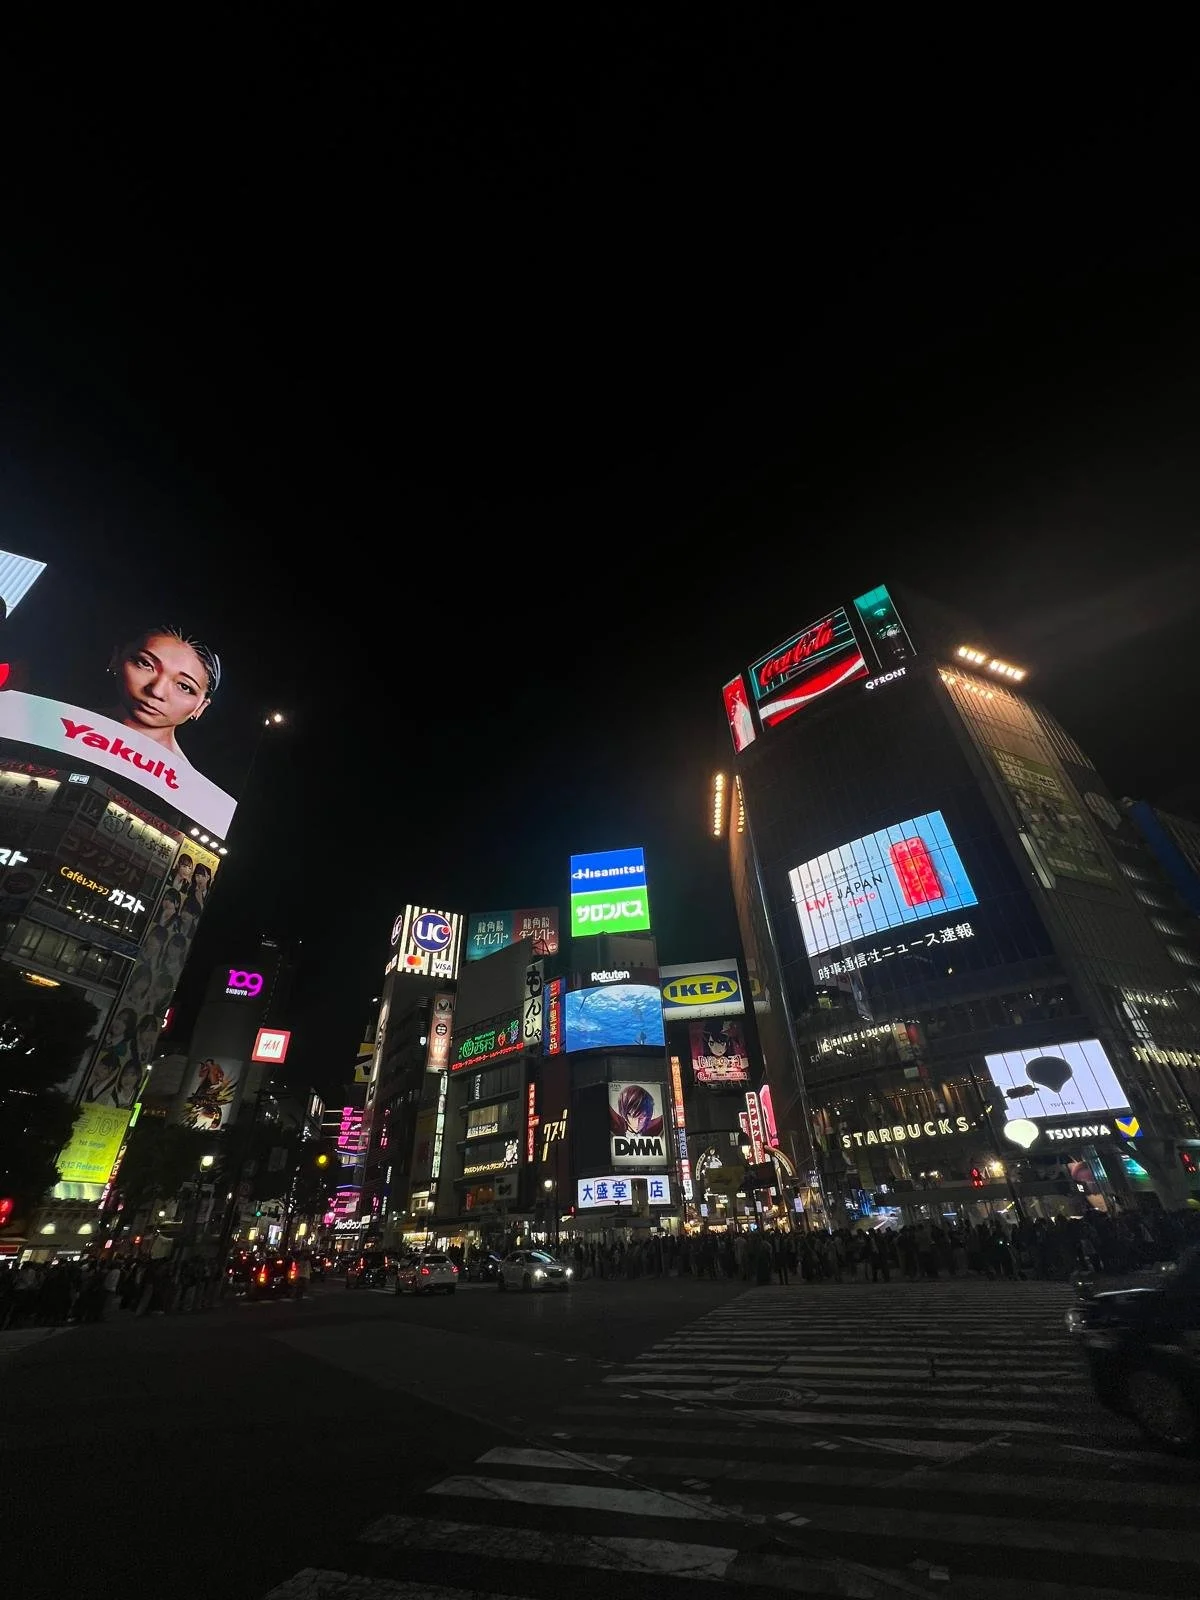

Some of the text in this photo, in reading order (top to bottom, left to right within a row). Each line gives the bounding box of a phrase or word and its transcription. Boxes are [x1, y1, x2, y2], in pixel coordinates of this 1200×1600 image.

[865, 667, 907, 690] QFRONT
[60, 717, 179, 790] Yakult
[572, 865, 644, 879] Hisamitsu
[107, 888, 146, 914] ガスト
[805, 891, 833, 912] LIVE
[837, 873, 883, 899] JAPAN
[848, 892, 876, 907] TOKYO
[575, 899, 644, 923] サロンパス
[818, 922, 975, 981] 時事通信社ニュース速報
[435, 962, 452, 971] VISA
[591, 970, 630, 982] Rakuten
[225, 987, 248, 996] SHIBUYA
[228, 969, 263, 997] 109
[669, 981, 733, 998] IKEA
[842, 1116, 969, 1148] STARBUCKS
[1045, 1125, 1111, 1140] TSUTAYA
[614, 1138, 664, 1156] DMM
